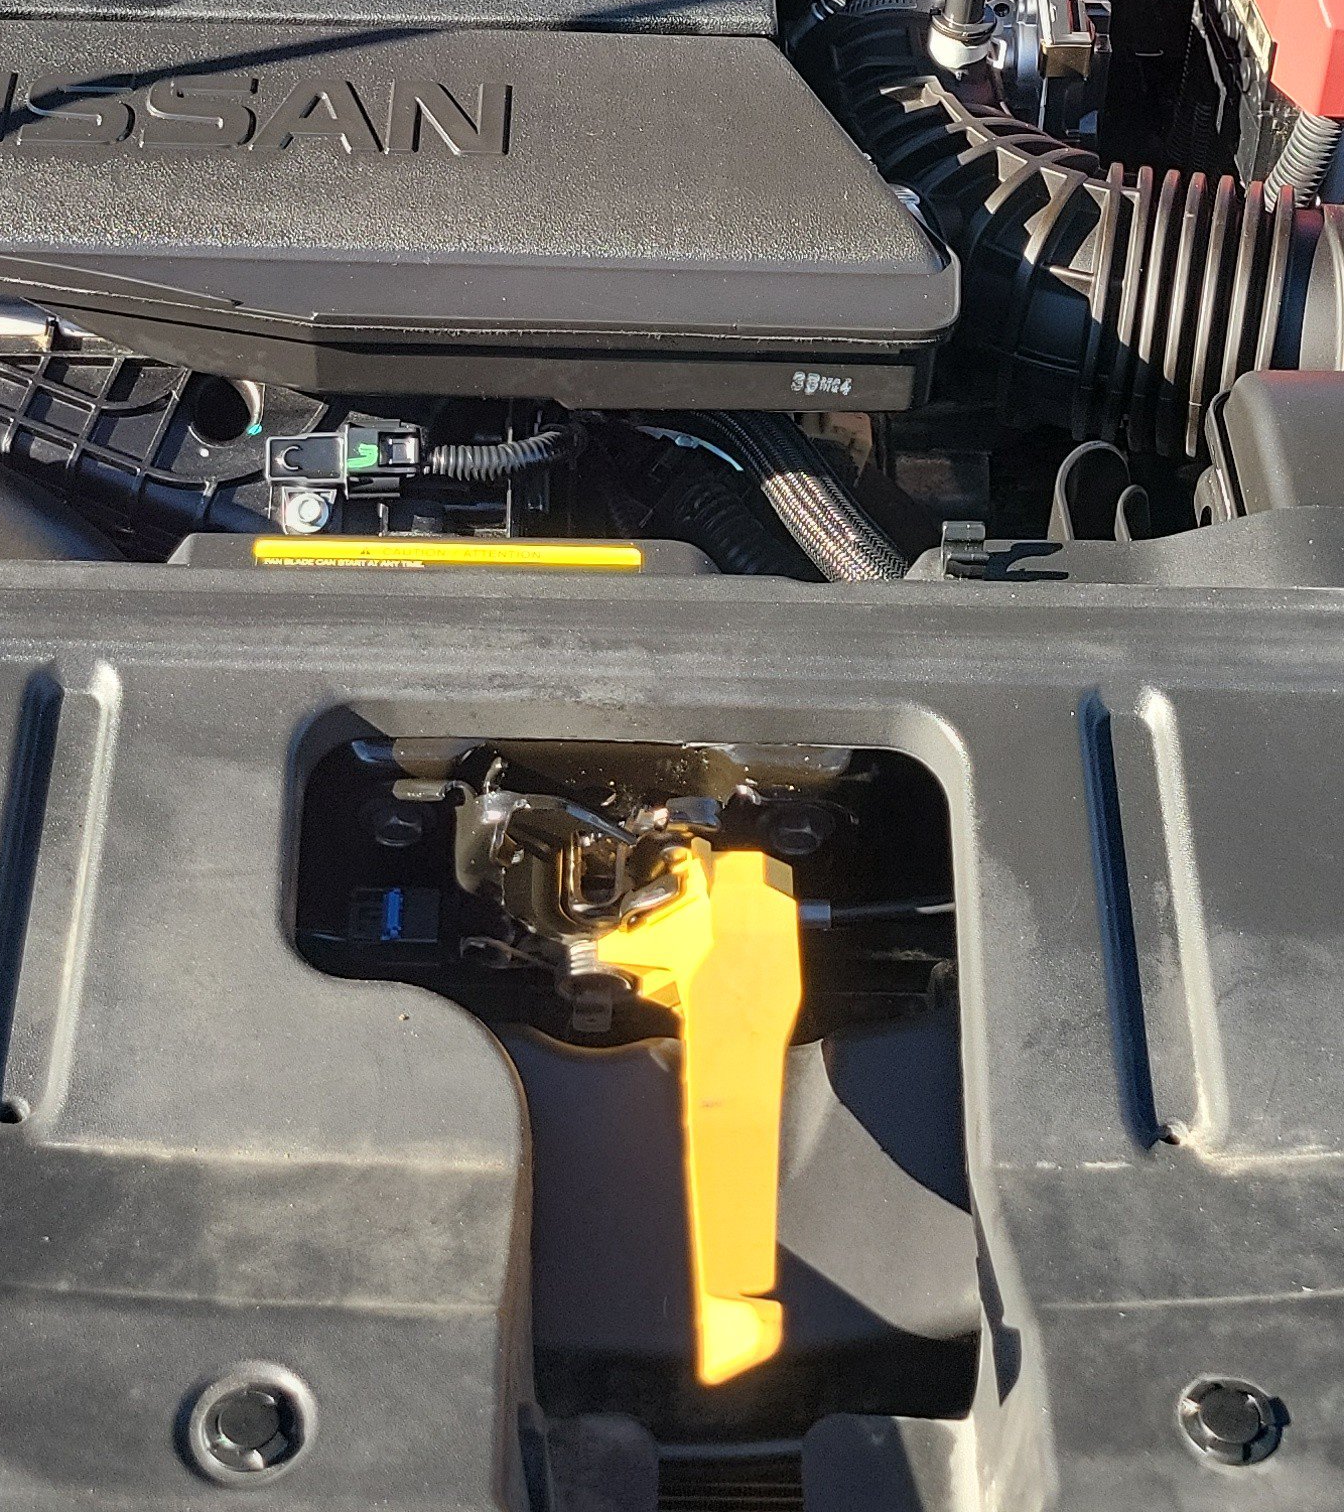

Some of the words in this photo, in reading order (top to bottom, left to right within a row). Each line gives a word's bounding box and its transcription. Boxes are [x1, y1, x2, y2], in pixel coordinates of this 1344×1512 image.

[383, 548, 446, 557] CAUTION
[463, 550, 542, 559] ATTENTION
[337, 559, 366, 567] START
